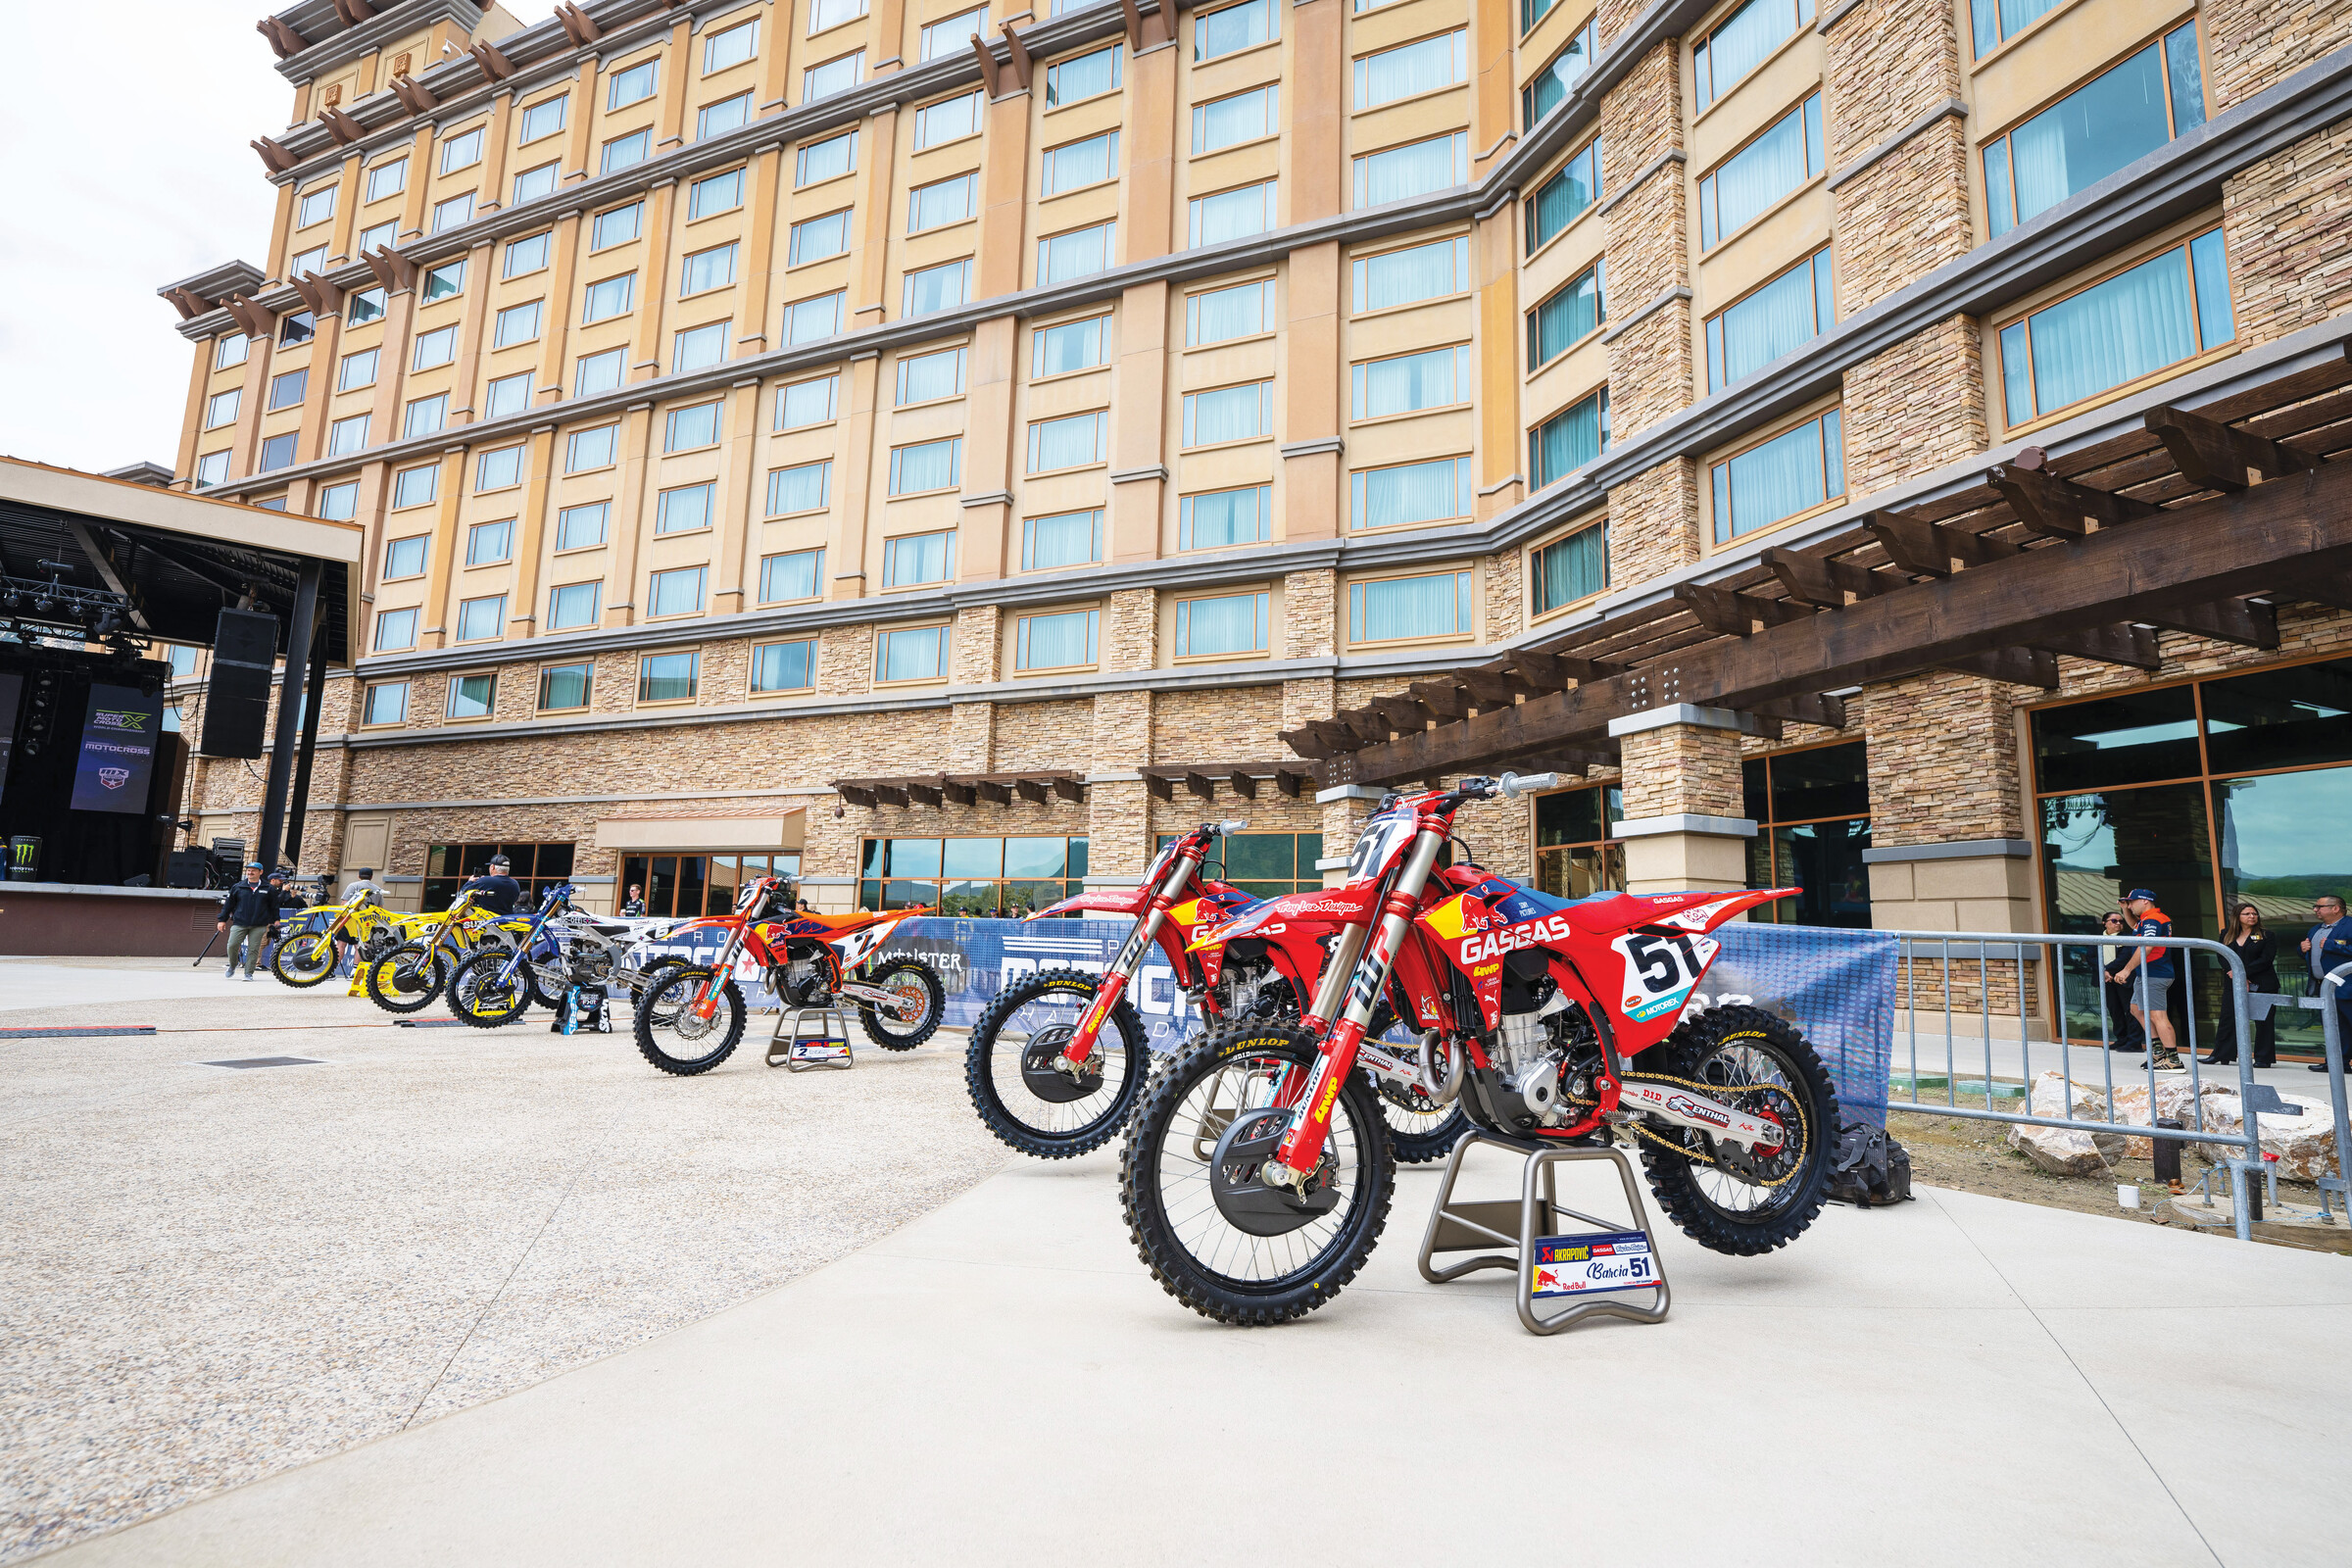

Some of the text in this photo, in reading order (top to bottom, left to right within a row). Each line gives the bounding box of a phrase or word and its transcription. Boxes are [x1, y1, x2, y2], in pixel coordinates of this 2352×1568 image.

[85, 743, 151, 755] MOTOCROSS
[1348, 822, 1398, 878] 51
[739, 889, 757, 909] 2
[1274, 899, 1363, 916] Troy Lee Designs
[1652, 896, 1684, 905] GASGAS
[854, 929, 878, 956] 2
[1460, 914, 1571, 965] GASGAS
[1625, 920, 1703, 994] 51
[890, 973, 948, 986] ENEY
[1048, 980, 1093, 991] DUNLOP
[1645, 997, 1680, 1016] MOTOREX
[1224, 1037, 1290, 1055] DUNLOP
[1720, 1030, 1768, 1047] DUNLOP
[798, 1048, 808, 1056] 2
[1298, 1066, 1322, 1121] DUNLOP
[1642, 1089, 1662, 1102] DID
[1554, 1246, 1589, 1262] AKRAPOVIČ
[1586, 1262, 1629, 1280] Barcia
[1629, 1256, 1651, 1278] 51
[1562, 1280, 1587, 1291] Red Bull
